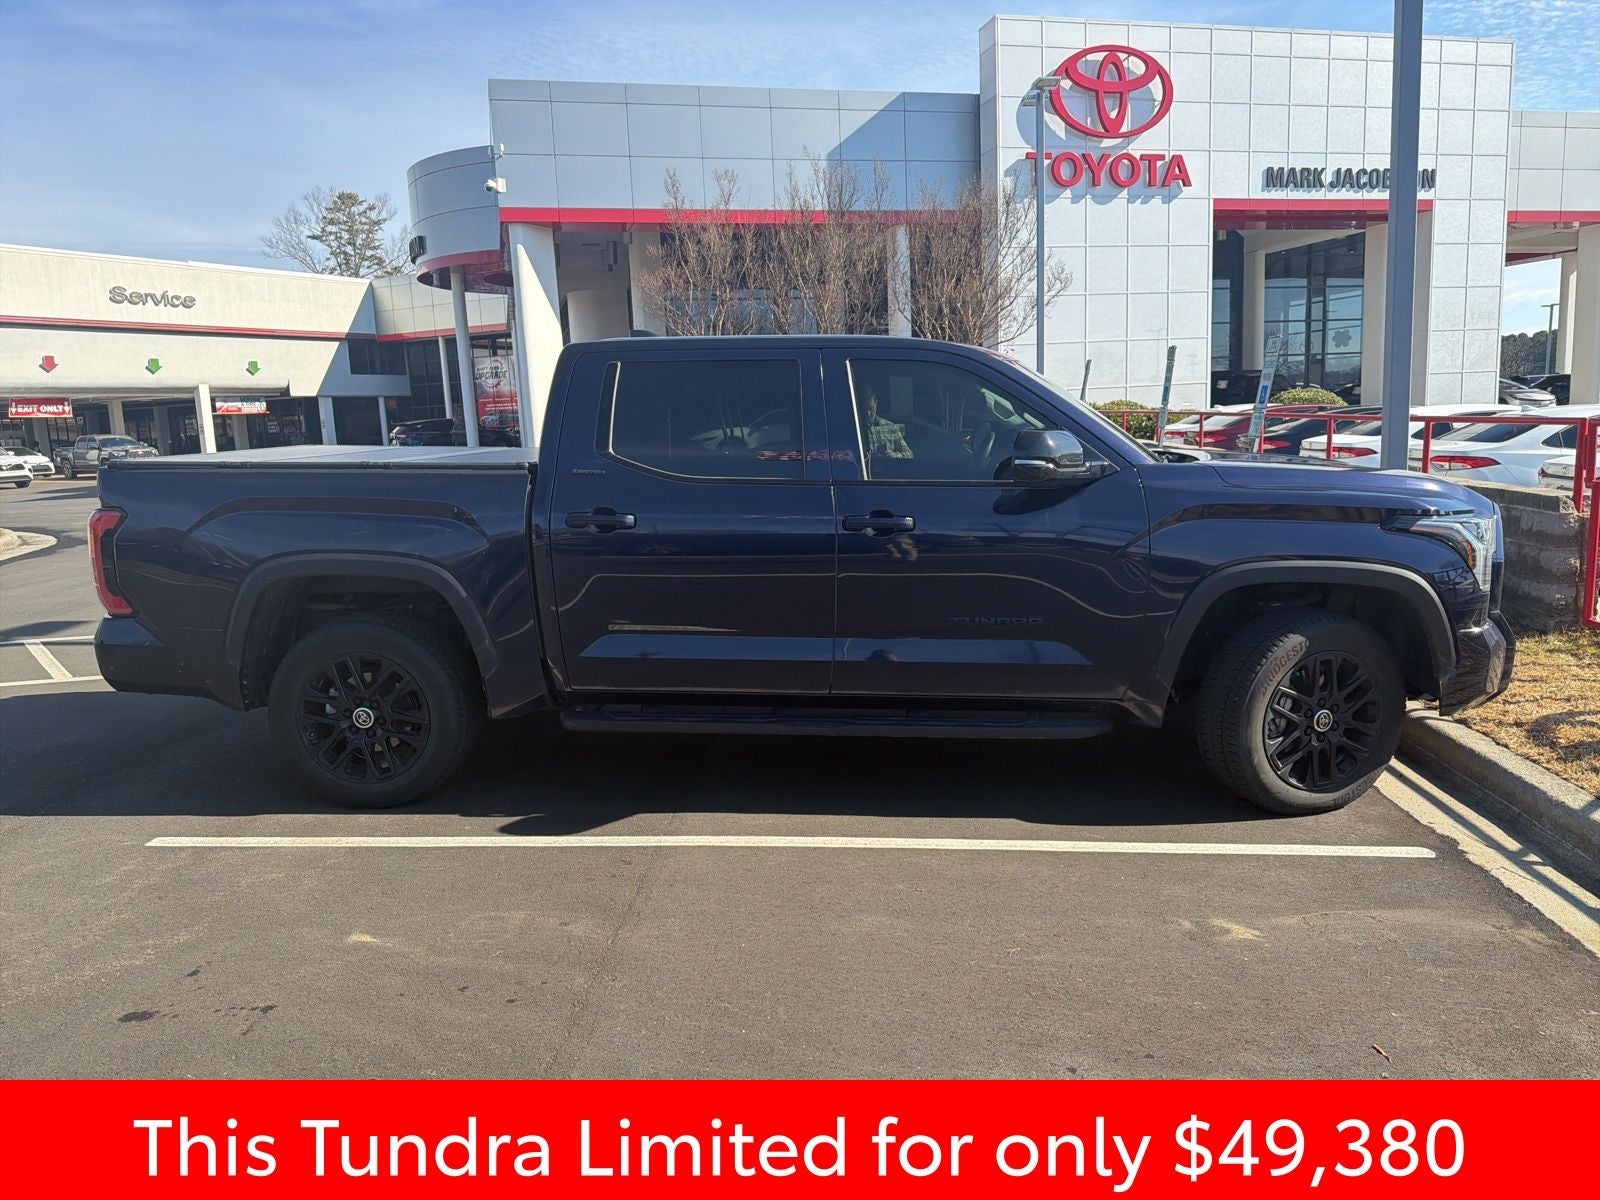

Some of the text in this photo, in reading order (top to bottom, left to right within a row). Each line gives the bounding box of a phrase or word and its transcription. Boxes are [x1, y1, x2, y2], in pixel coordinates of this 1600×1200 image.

[1266, 166, 1436, 189] MARK JACOBN
[109, 286, 196, 309] Service
[475, 370, 508, 381] UPGRADE
[17, 404, 64, 413] EXIT ONLY
[949, 616, 1044, 625] TUNDRA
